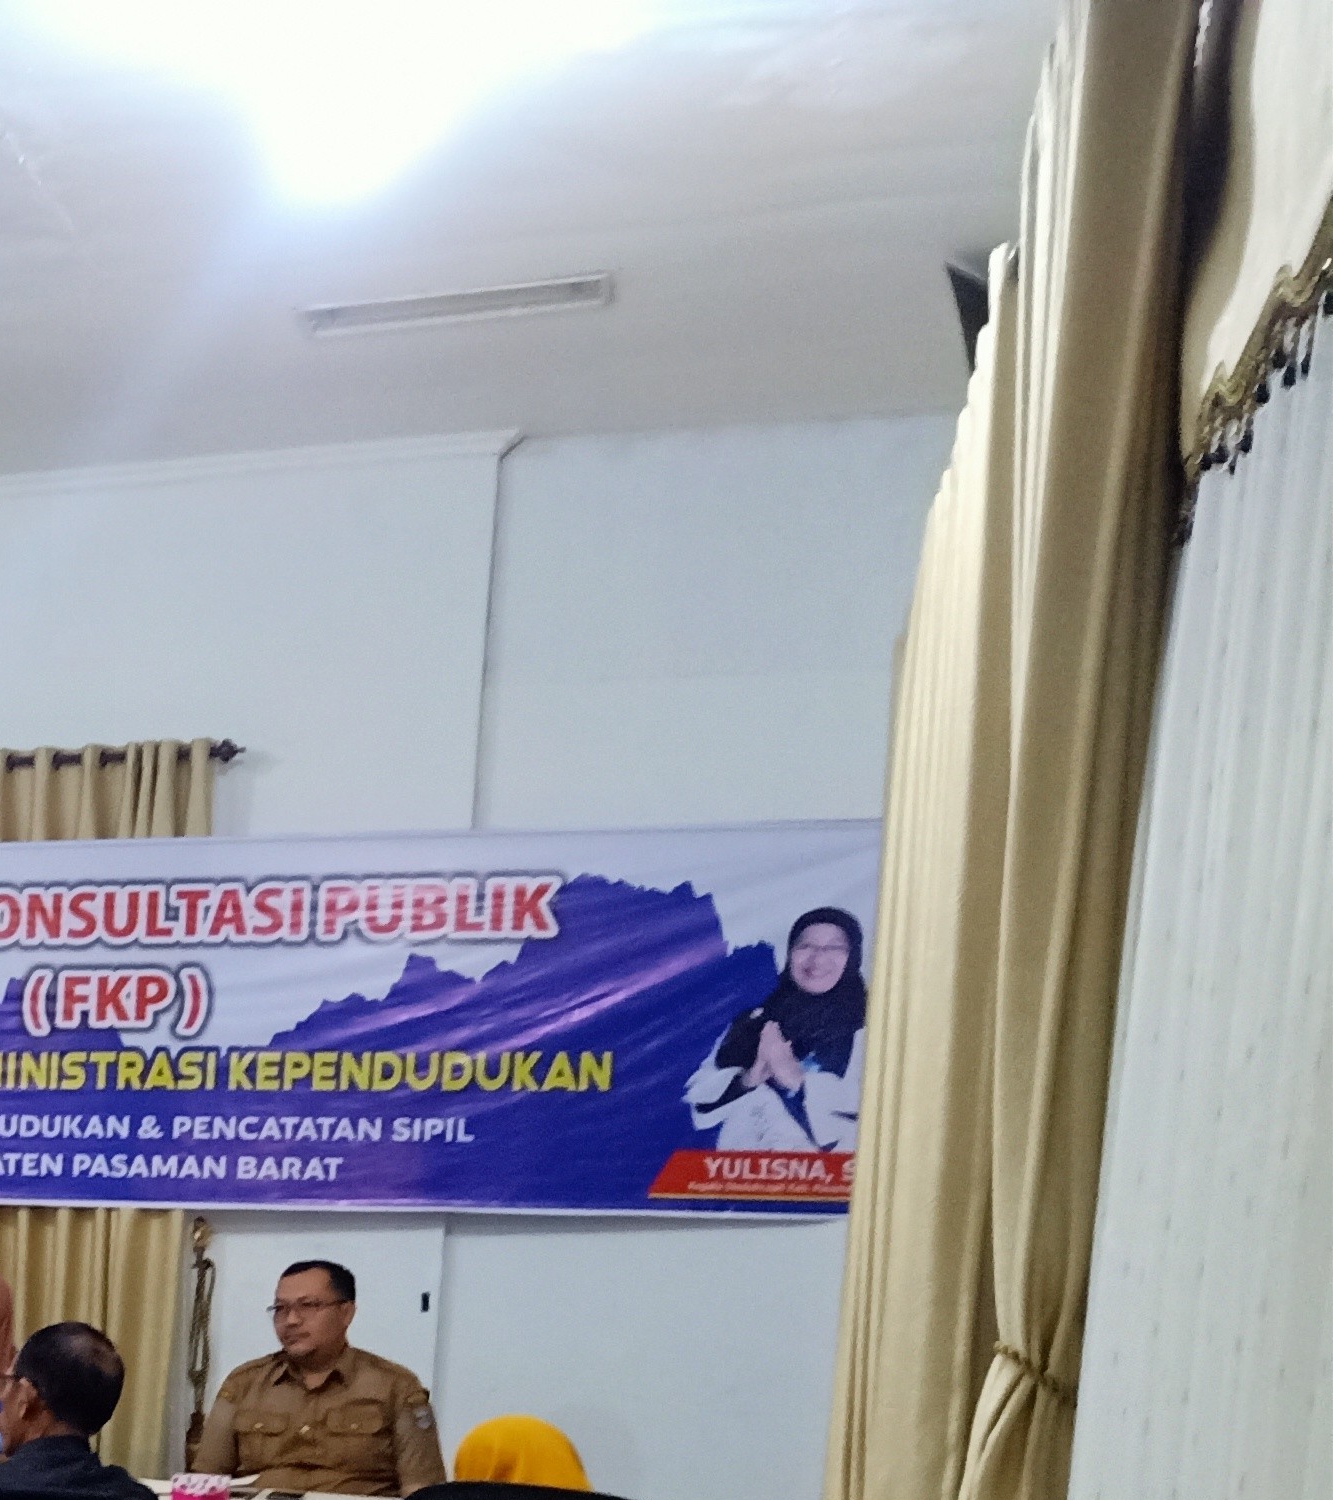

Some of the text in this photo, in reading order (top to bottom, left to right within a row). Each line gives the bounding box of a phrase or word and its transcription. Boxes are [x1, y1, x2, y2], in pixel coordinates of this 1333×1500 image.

[322, 881, 555, 937] PUBLIK
[28, 974, 203, 1031] (FKP)
[227, 1050, 614, 1092] KEPENDUDUKAN
[137, 1115, 165, 1140] &
[171, 1115, 383, 1142] PENCATATAN
[391, 1117, 476, 1143] SIPIL
[71, 1153, 228, 1180] PASAMAN
[236, 1156, 345, 1182] BARAT
[703, 1156, 834, 1183] YULISNA,
